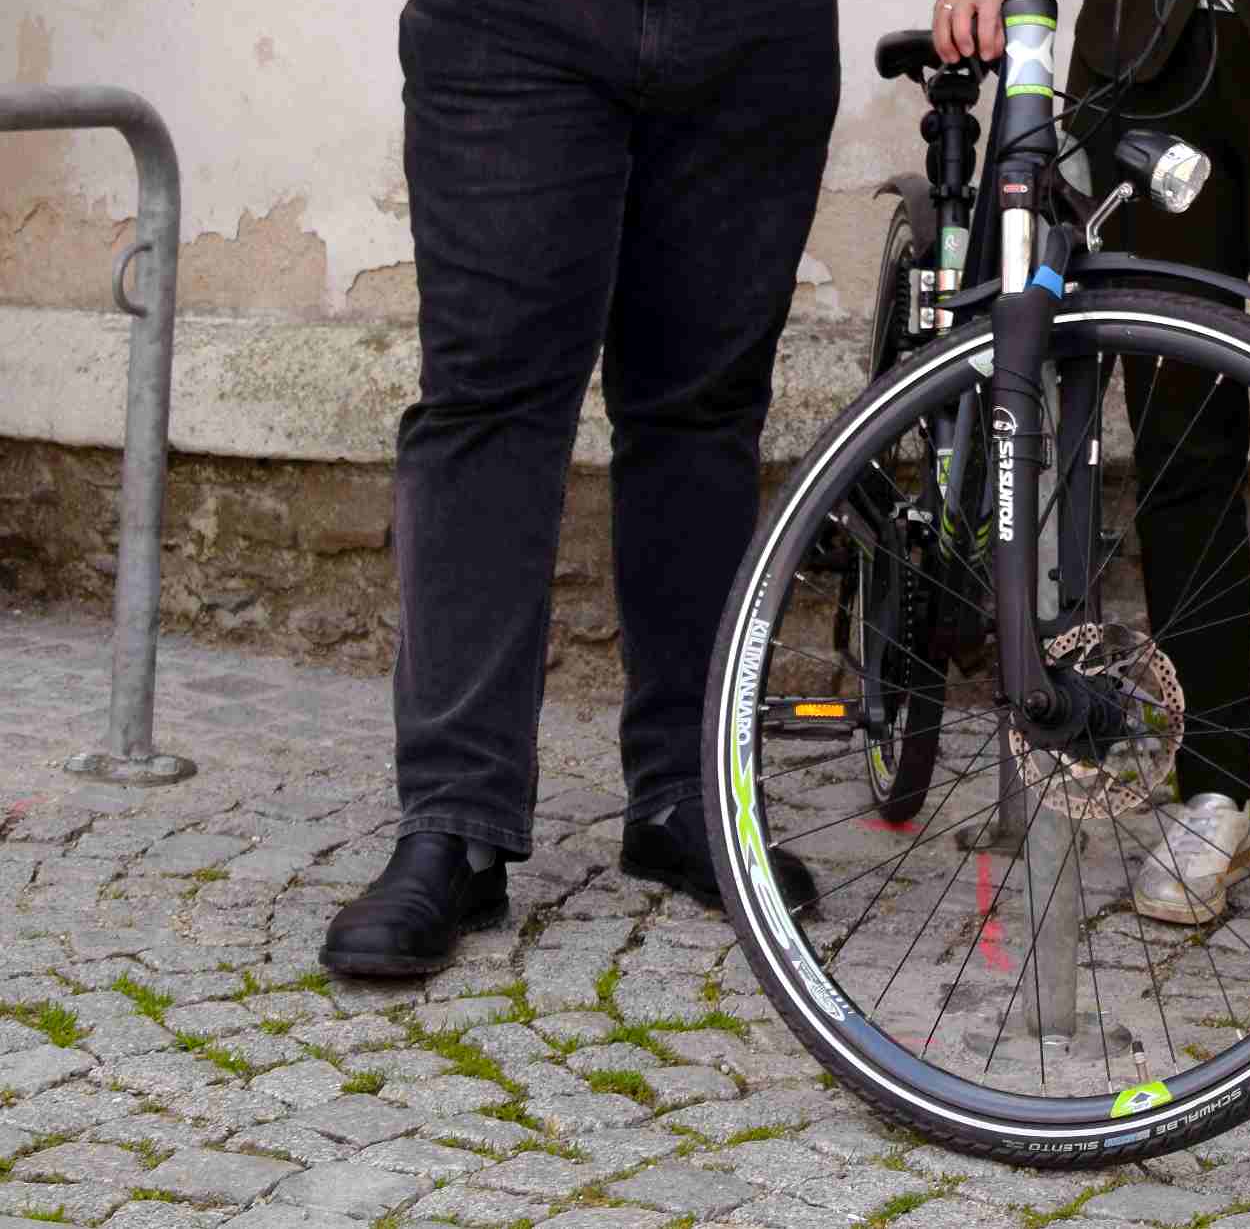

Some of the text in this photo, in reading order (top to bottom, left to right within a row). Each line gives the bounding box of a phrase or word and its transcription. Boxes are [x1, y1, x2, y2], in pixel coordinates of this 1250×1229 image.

[999, 470, 1015, 542] SUNTOUR
[735, 619, 770, 747] KILIMANJARO
[1155, 1087, 1243, 1135] SCHWALBE
[1027, 1140, 1100, 1152] SILENTO
